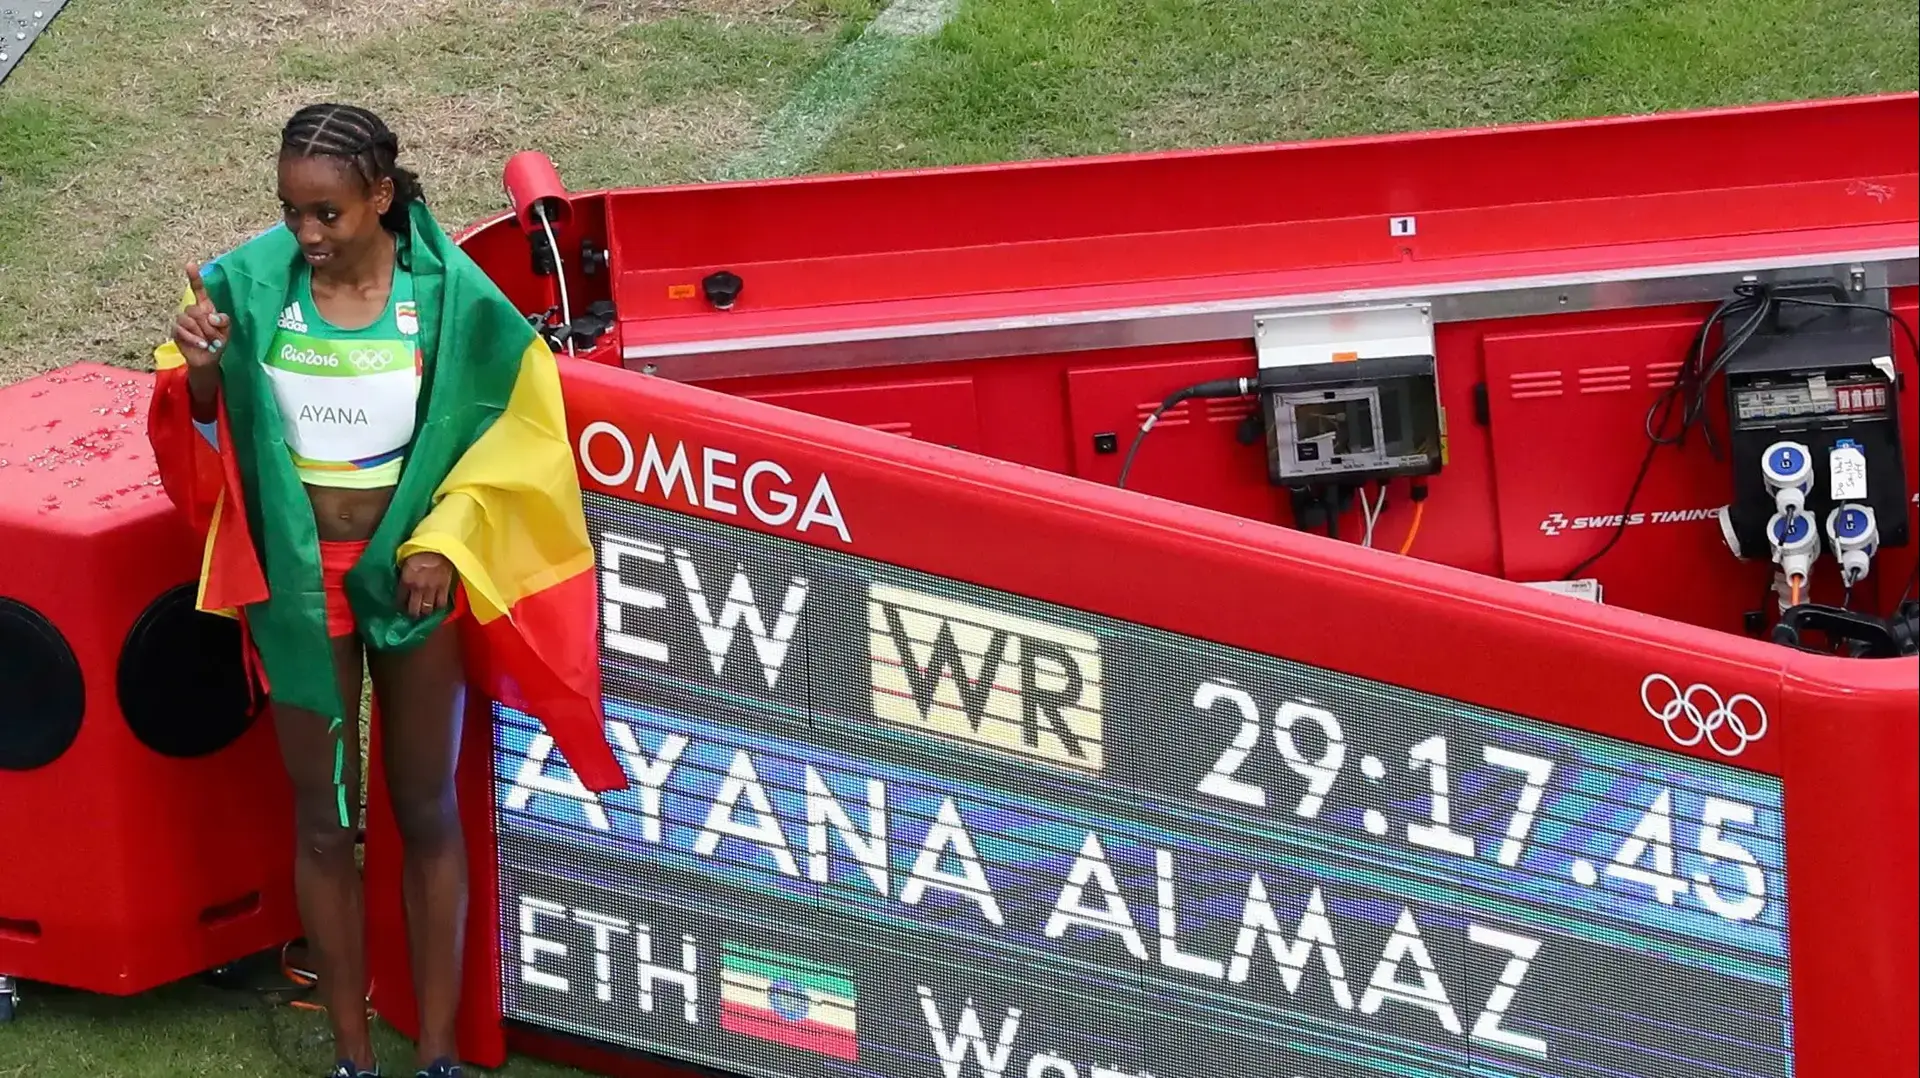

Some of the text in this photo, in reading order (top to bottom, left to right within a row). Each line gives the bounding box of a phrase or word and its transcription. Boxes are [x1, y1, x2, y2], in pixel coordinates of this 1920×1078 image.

[1397, 219, 1408, 233] 1
[277, 316, 308, 333] adidas
[280, 343, 339, 367] Rio2016
[299, 404, 368, 425] AYANA
[579, 421, 852, 543] OMEGA
[1571, 513, 1645, 530] SWISS
[600, 532, 1769, 921] EW WR 29:17.45
[503, 716, 1548, 1059] AYANA ALMAZ
[518, 895, 698, 1025] ETH
